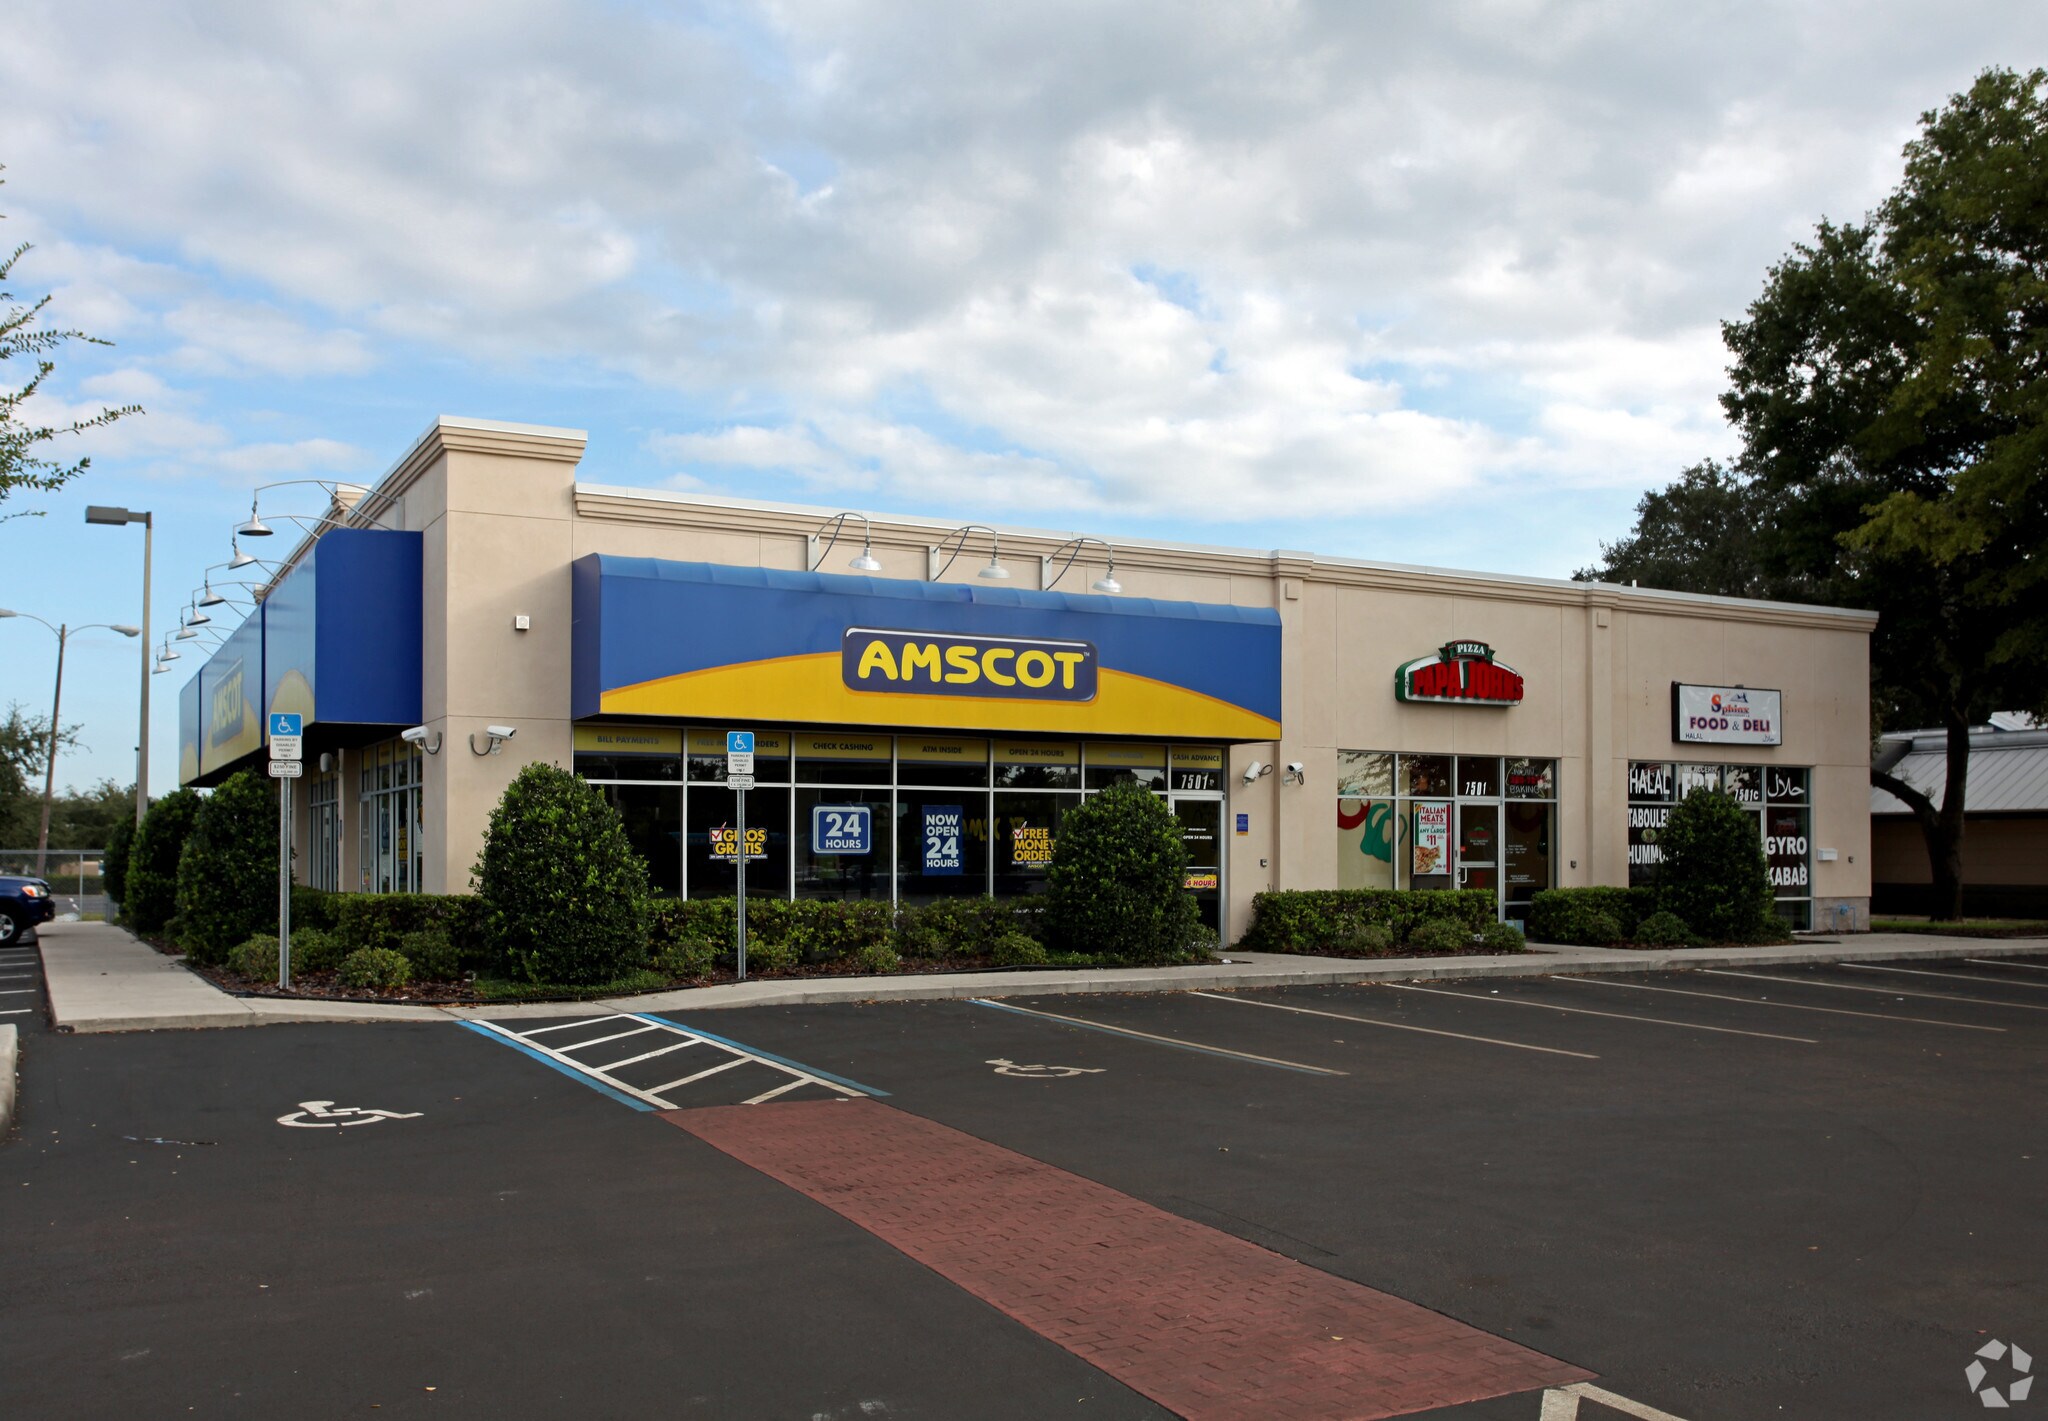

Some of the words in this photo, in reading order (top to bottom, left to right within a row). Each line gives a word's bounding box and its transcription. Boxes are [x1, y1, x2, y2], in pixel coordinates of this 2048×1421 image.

[1457, 643, 1485, 654] PIZZA
[857, 640, 1085, 690] AMSCOT
[1413, 660, 1462, 697] PAPA
[1711, 694, 1750, 715] Sphinx
[1690, 717, 1729, 730] FOOD
[1732, 721, 1740, 731] &
[1743, 719, 1770, 732] DELI
[597, 735, 614, 744] BILL
[615, 736, 660, 745] PAYMENTS
[1685, 732, 1703, 740] HALAL
[754, 739, 779, 749] RDERS
[812, 742, 837, 751] CHECK
[839, 743, 874, 752] CASHING
[921, 745, 938, 753] ATM
[939, 746, 962, 754] INSIDE
[1009, 748, 1028, 757] OPEN
[1030, 749, 1039, 757] 24
[1040, 750, 1065, 758] HOURS
[1172, 754, 1190, 762] CASH
[1190, 755, 1220, 763] ADVANCE
[1181, 774, 1209, 790] 7501
[1629, 768, 1670, 795] HALAL
[1767, 773, 1805, 797] حلال
[1465, 781, 1487, 796] 7501
[1419, 806, 1446, 815] ITALIAN
[926, 814, 959, 826] NOW
[1420, 814, 1444, 822] MEATS
[825, 813, 862, 837] 24
[926, 826, 959, 837] OPEN
[1023, 828, 1049, 839] FREE
[825, 839, 862, 849] HOURS
[1014, 839, 1057, 851] MONEY
[1426, 834, 1437, 846] $11
[1766, 836, 1807, 855] GYRO
[926, 837, 959, 858] 24
[1013, 850, 1056, 861] ORDER
[926, 859, 960, 868] HOURS
[1768, 866, 1808, 886] KABAB
[1193, 879, 1216, 887] HOURS
